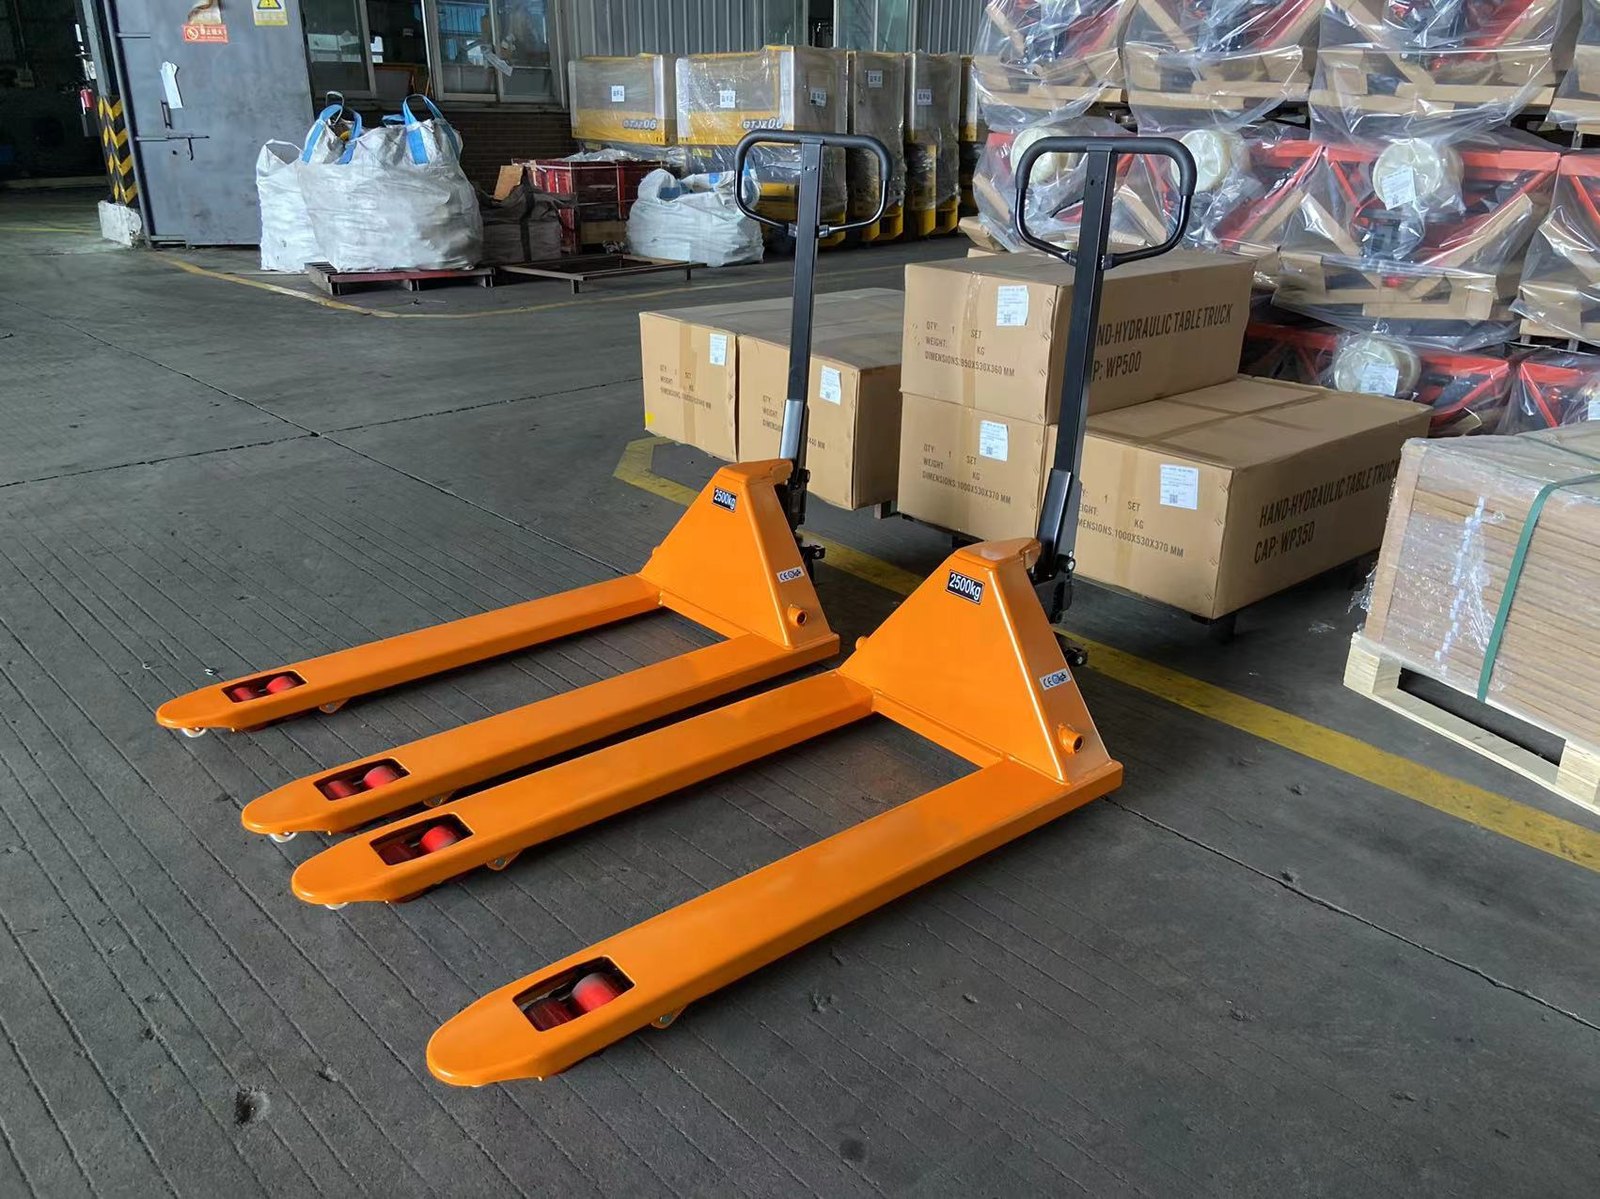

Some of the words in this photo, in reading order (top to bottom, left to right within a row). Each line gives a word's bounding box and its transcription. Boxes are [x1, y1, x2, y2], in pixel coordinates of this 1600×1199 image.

[1097, 314, 1173, 346] ND-HYDRAULIC
[1173, 309, 1203, 333] TABLE
[1203, 304, 1233, 327] TRUCK
[970, 329, 982, 339] SET
[977, 346, 985, 357] KG
[1092, 360, 1103, 382] P:
[1106, 351, 1142, 378] WP500
[966, 455, 977, 466] SET
[714, 488, 736, 510] 2500kg
[1259, 478, 1346, 528] HAND-HYDRAULIC
[1346, 466, 1373, 495] TABLE
[1127, 501, 1141, 513] SET
[1134, 518, 1145, 530] KG
[1254, 535, 1279, 564] CAP:
[1280, 521, 1315, 553] WP350
[1169, 545, 1184, 558] MM
[949, 574, 981, 600] 2500kg
